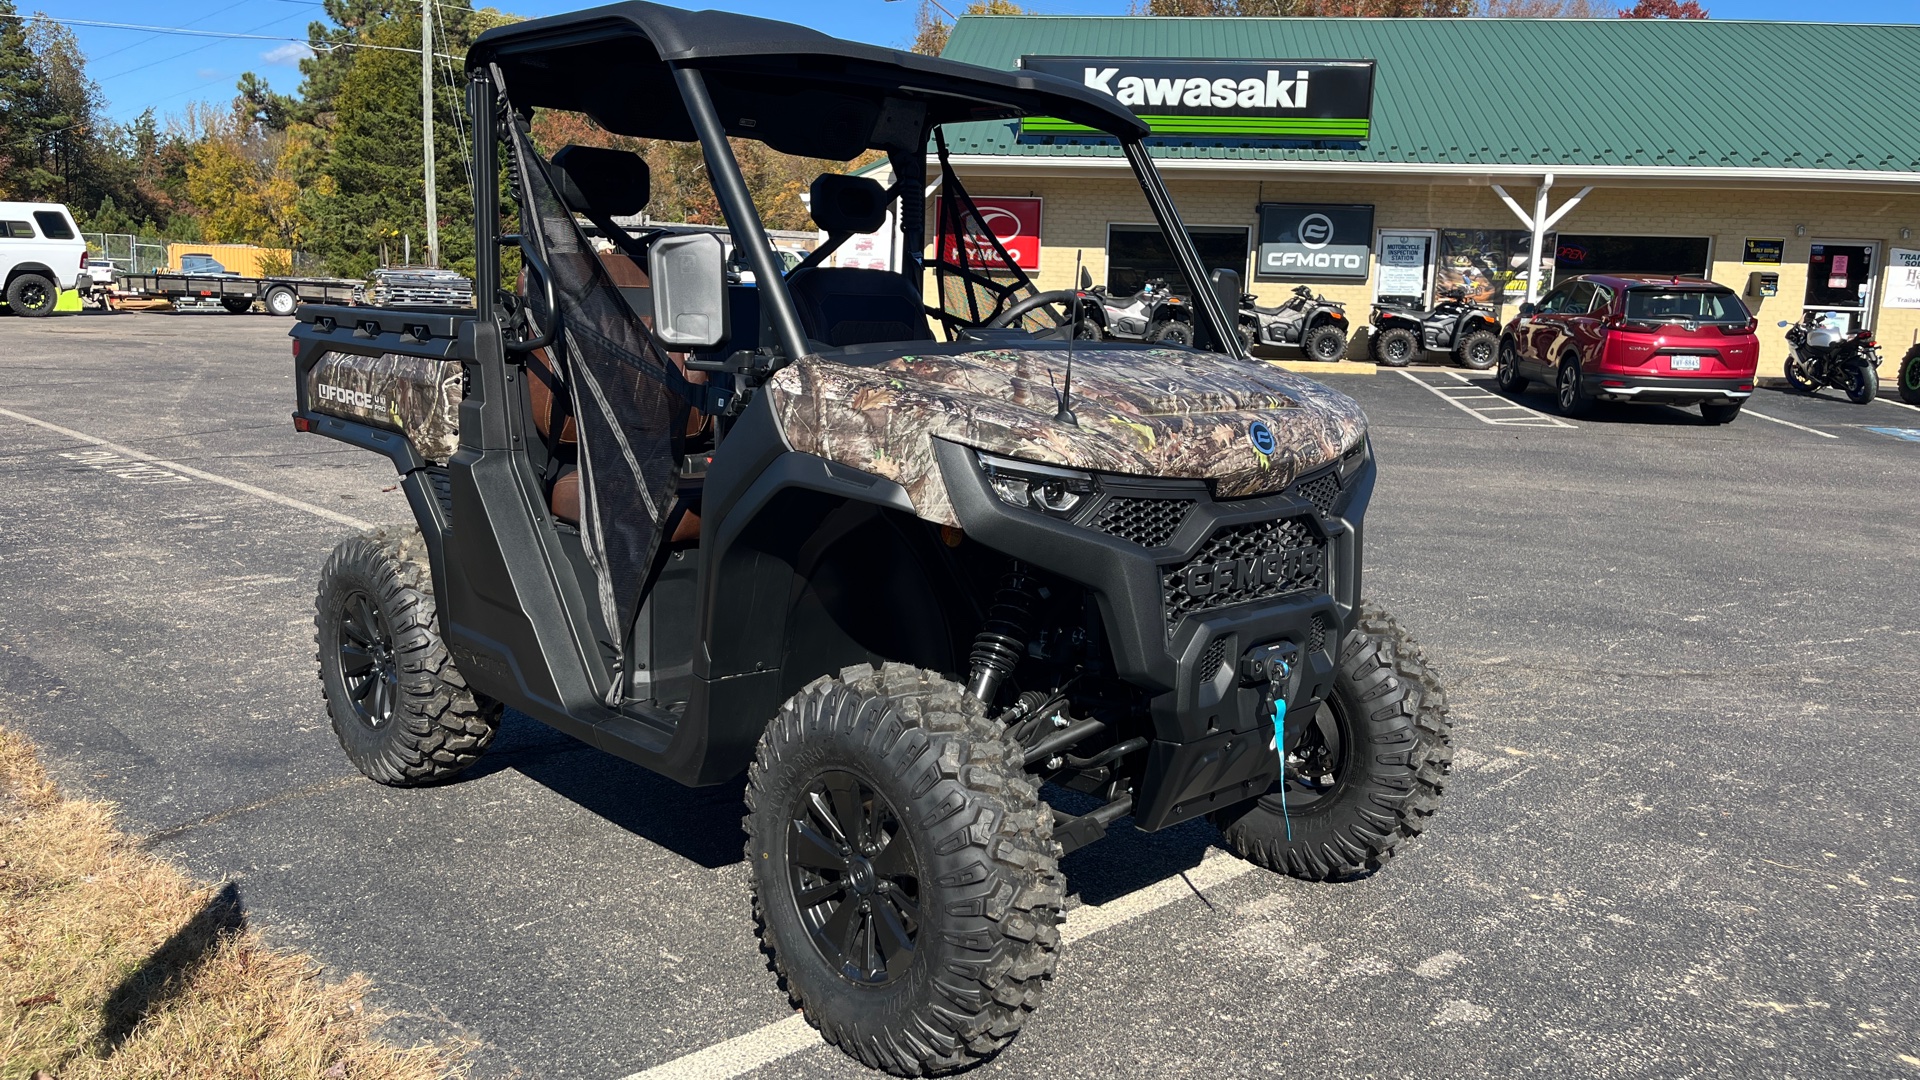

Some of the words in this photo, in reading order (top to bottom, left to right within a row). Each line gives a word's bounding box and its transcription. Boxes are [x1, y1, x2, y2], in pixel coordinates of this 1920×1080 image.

[1084, 67, 1309, 109] Kawasaki
[1267, 252, 1360, 269] CFMOTO
[1556, 246, 1588, 261] OPEN
[1492, 270, 1517, 281] READY
[1503, 279, 1543, 291] ANYTHG
[318, 383, 373, 409] UFORCE
[374, 404, 386, 412] PRO
[1186, 544, 1319, 597] CFMOTO
